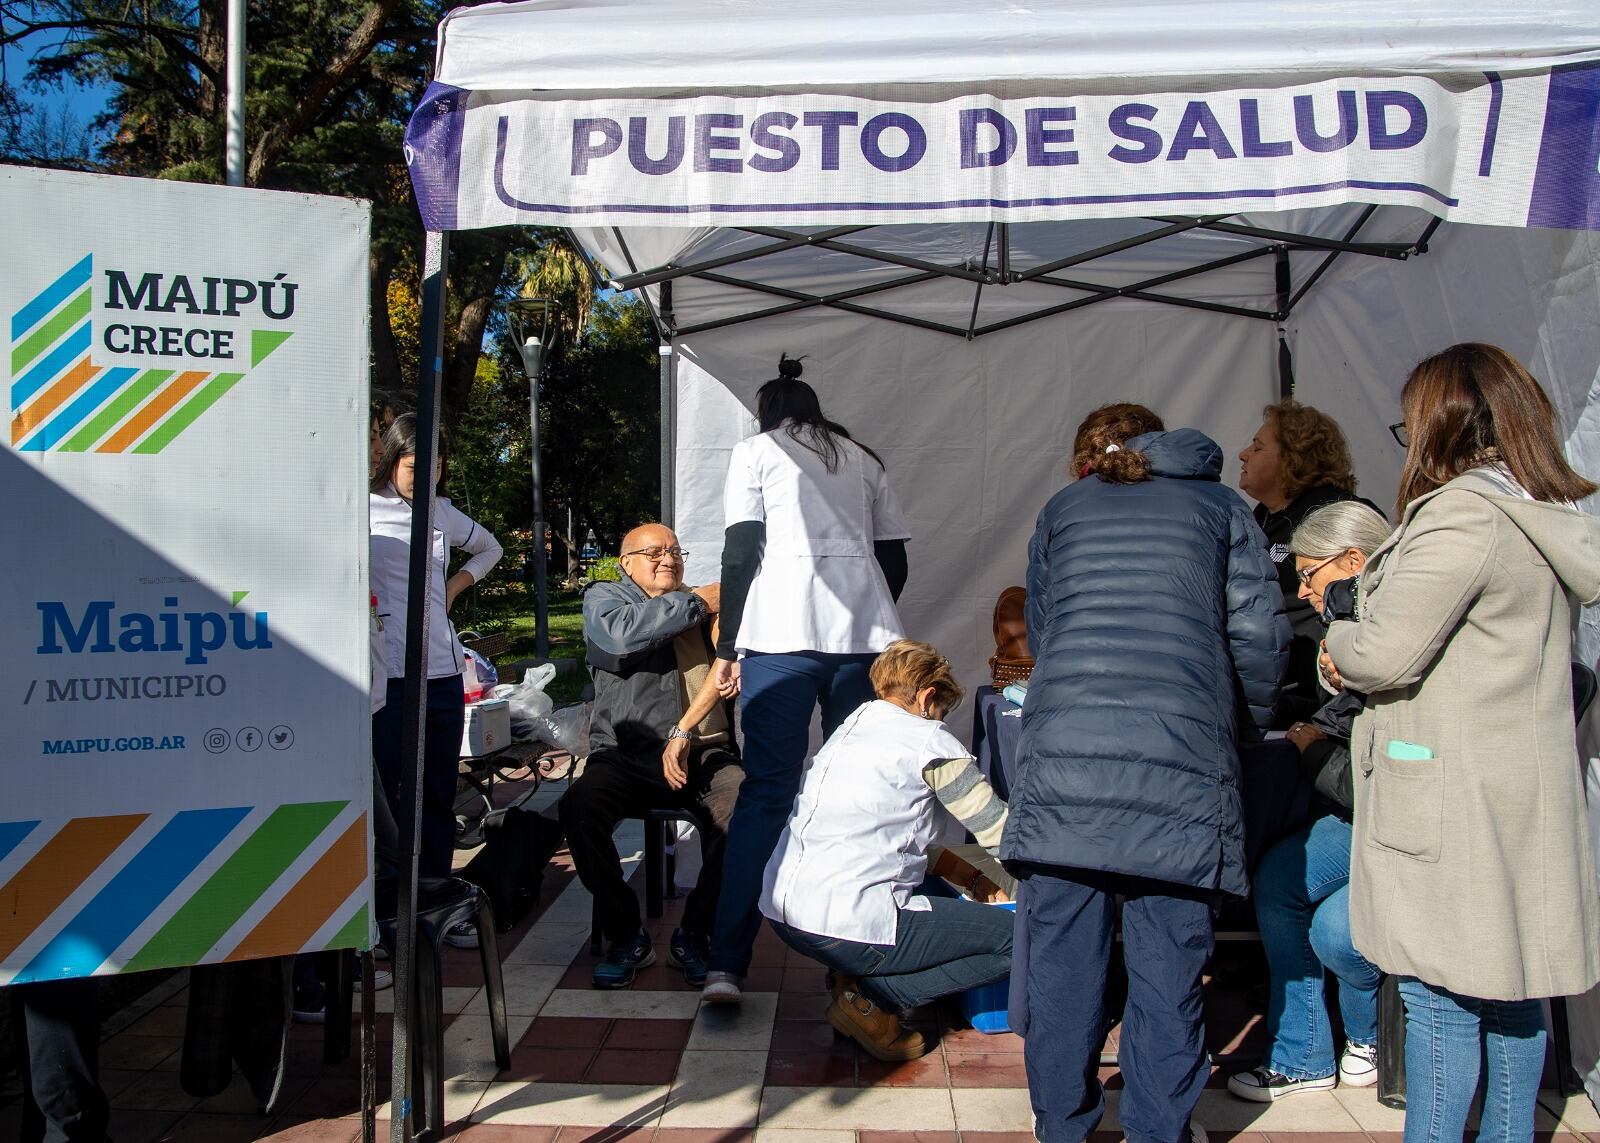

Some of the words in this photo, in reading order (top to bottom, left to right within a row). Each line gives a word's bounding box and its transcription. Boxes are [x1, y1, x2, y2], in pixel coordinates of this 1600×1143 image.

[572, 112, 927, 175] PUESTO
[960, 107, 1079, 169] DE
[1107, 90, 1427, 163] SALUD
[104, 269, 299, 320] MAIPÚ
[104, 324, 234, 359] CRECE
[36, 591, 273, 664] Maipú
[46, 675, 227, 703] MUNICIPIO
[42, 736, 186, 754] MAIPU.GOB.AR
